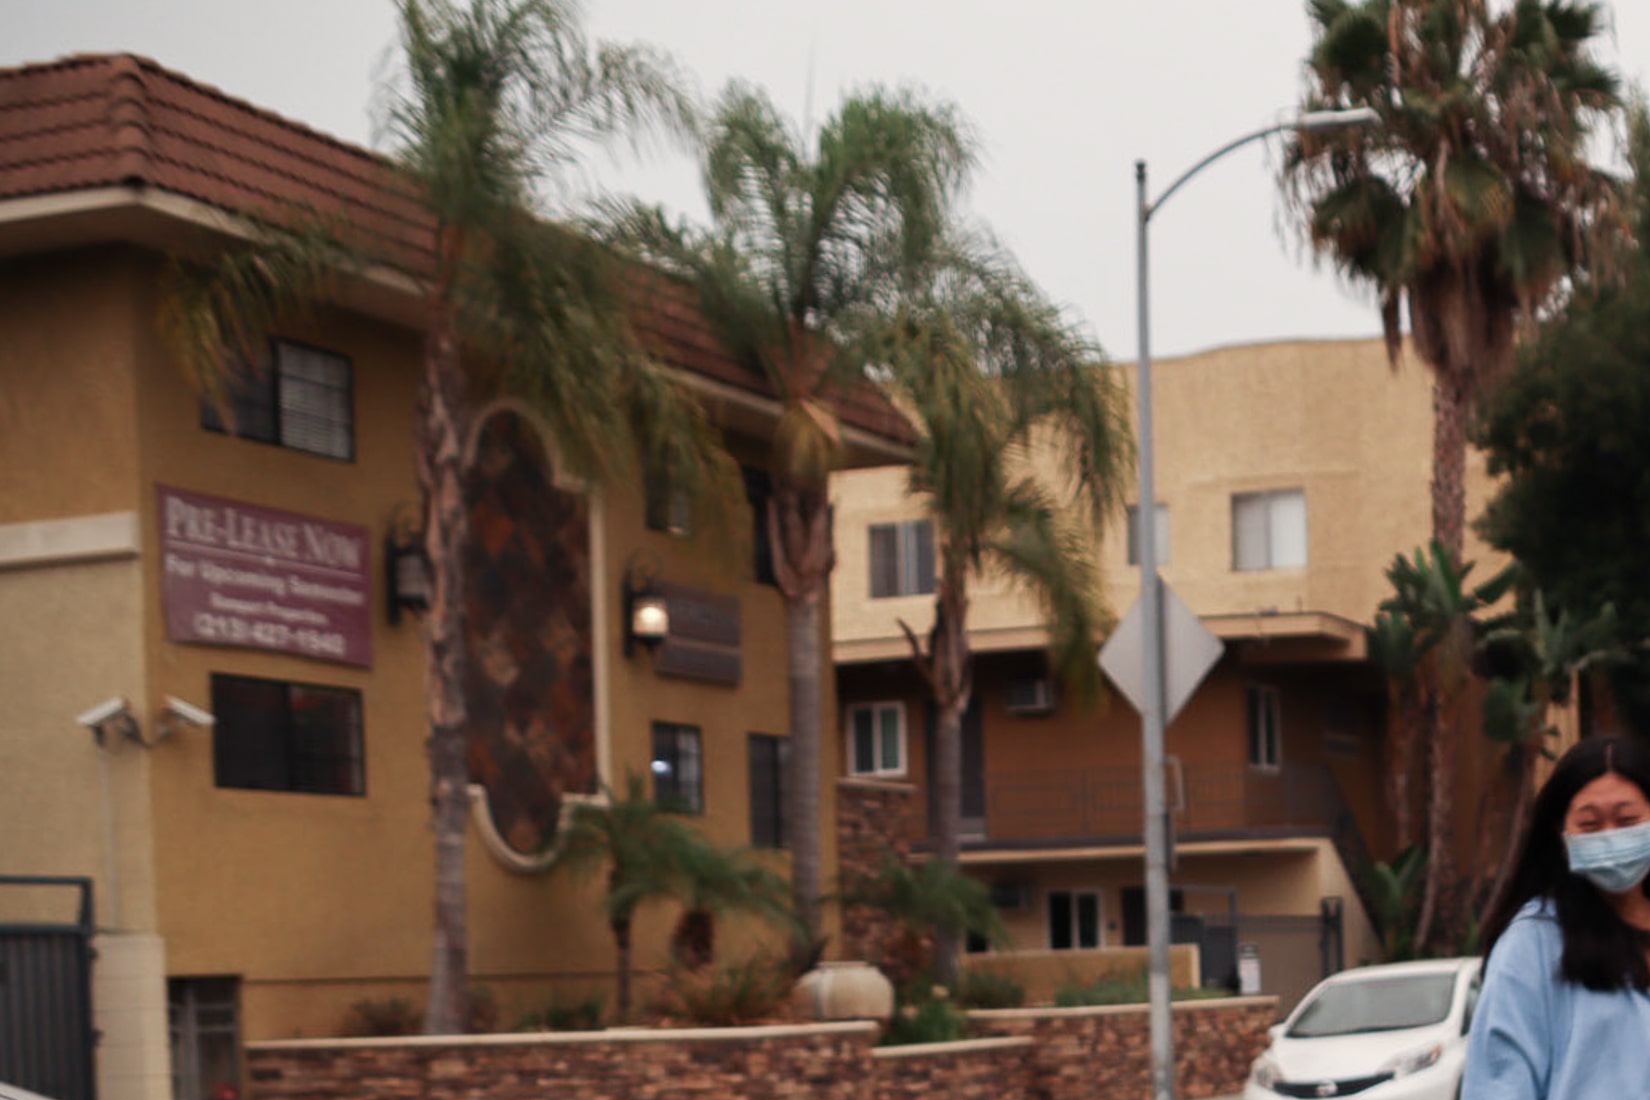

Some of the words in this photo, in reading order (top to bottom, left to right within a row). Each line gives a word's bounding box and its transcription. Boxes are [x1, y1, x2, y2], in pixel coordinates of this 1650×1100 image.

[164, 495, 298, 558] PRE-LEASE
[302, 522, 360, 567] NOW
[164, 552, 196, 577] For
